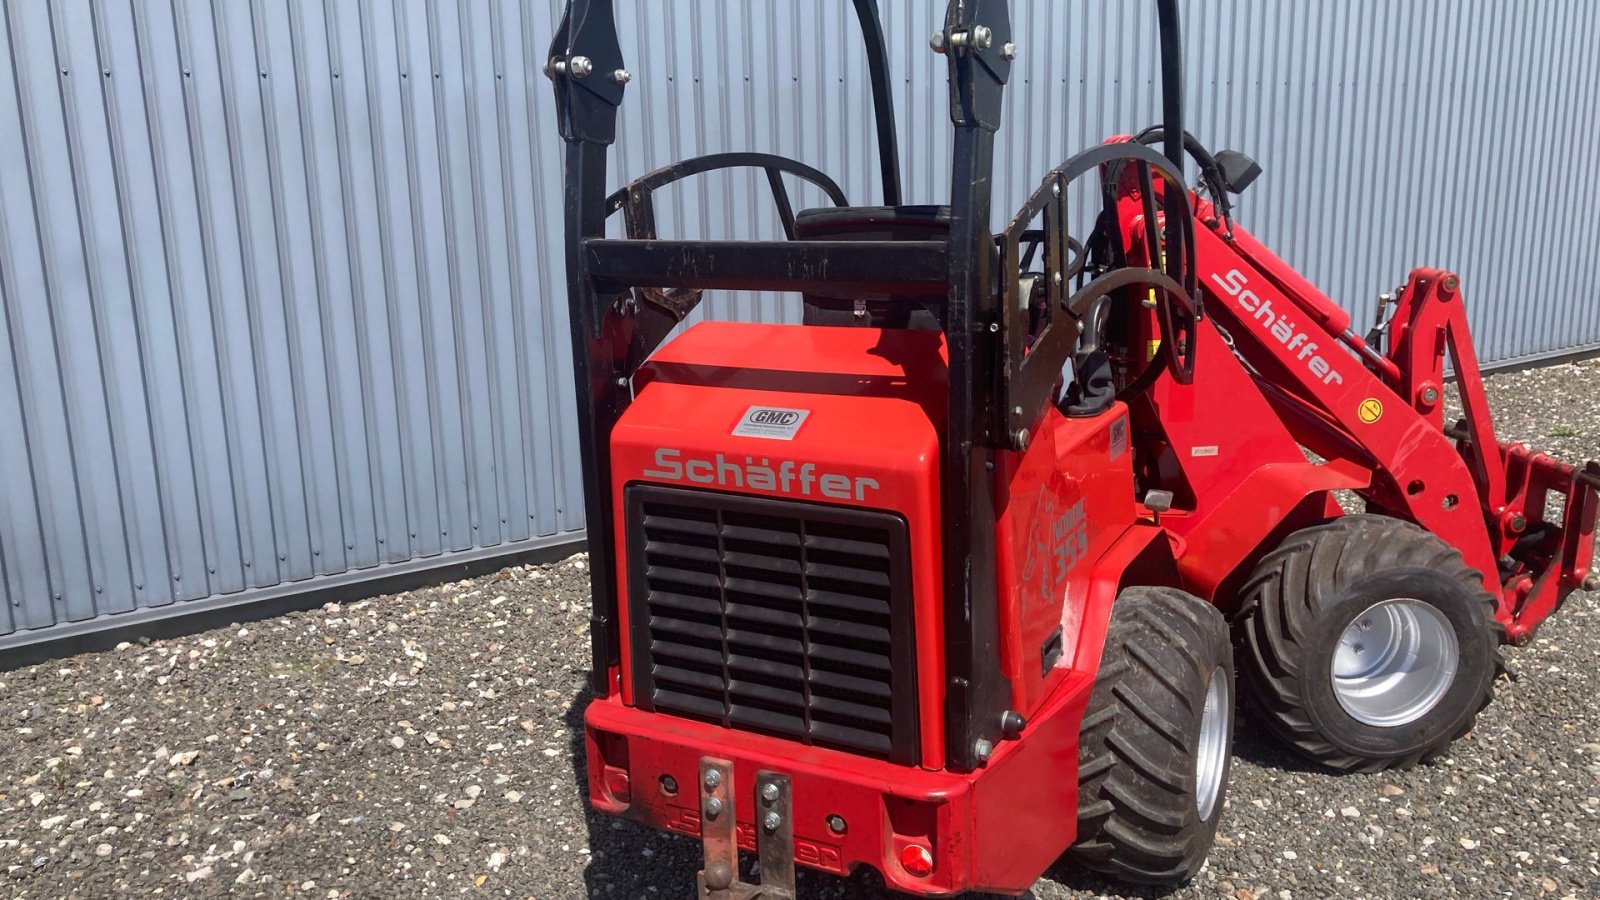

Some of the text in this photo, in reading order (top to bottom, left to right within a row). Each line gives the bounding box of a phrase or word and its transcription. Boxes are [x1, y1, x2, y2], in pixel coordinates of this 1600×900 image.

[1211, 268, 1343, 386] Schäffer
[755, 411, 793, 424] GMC
[643, 448, 880, 501] Schäffer
[1053, 521, 1088, 584] 355
